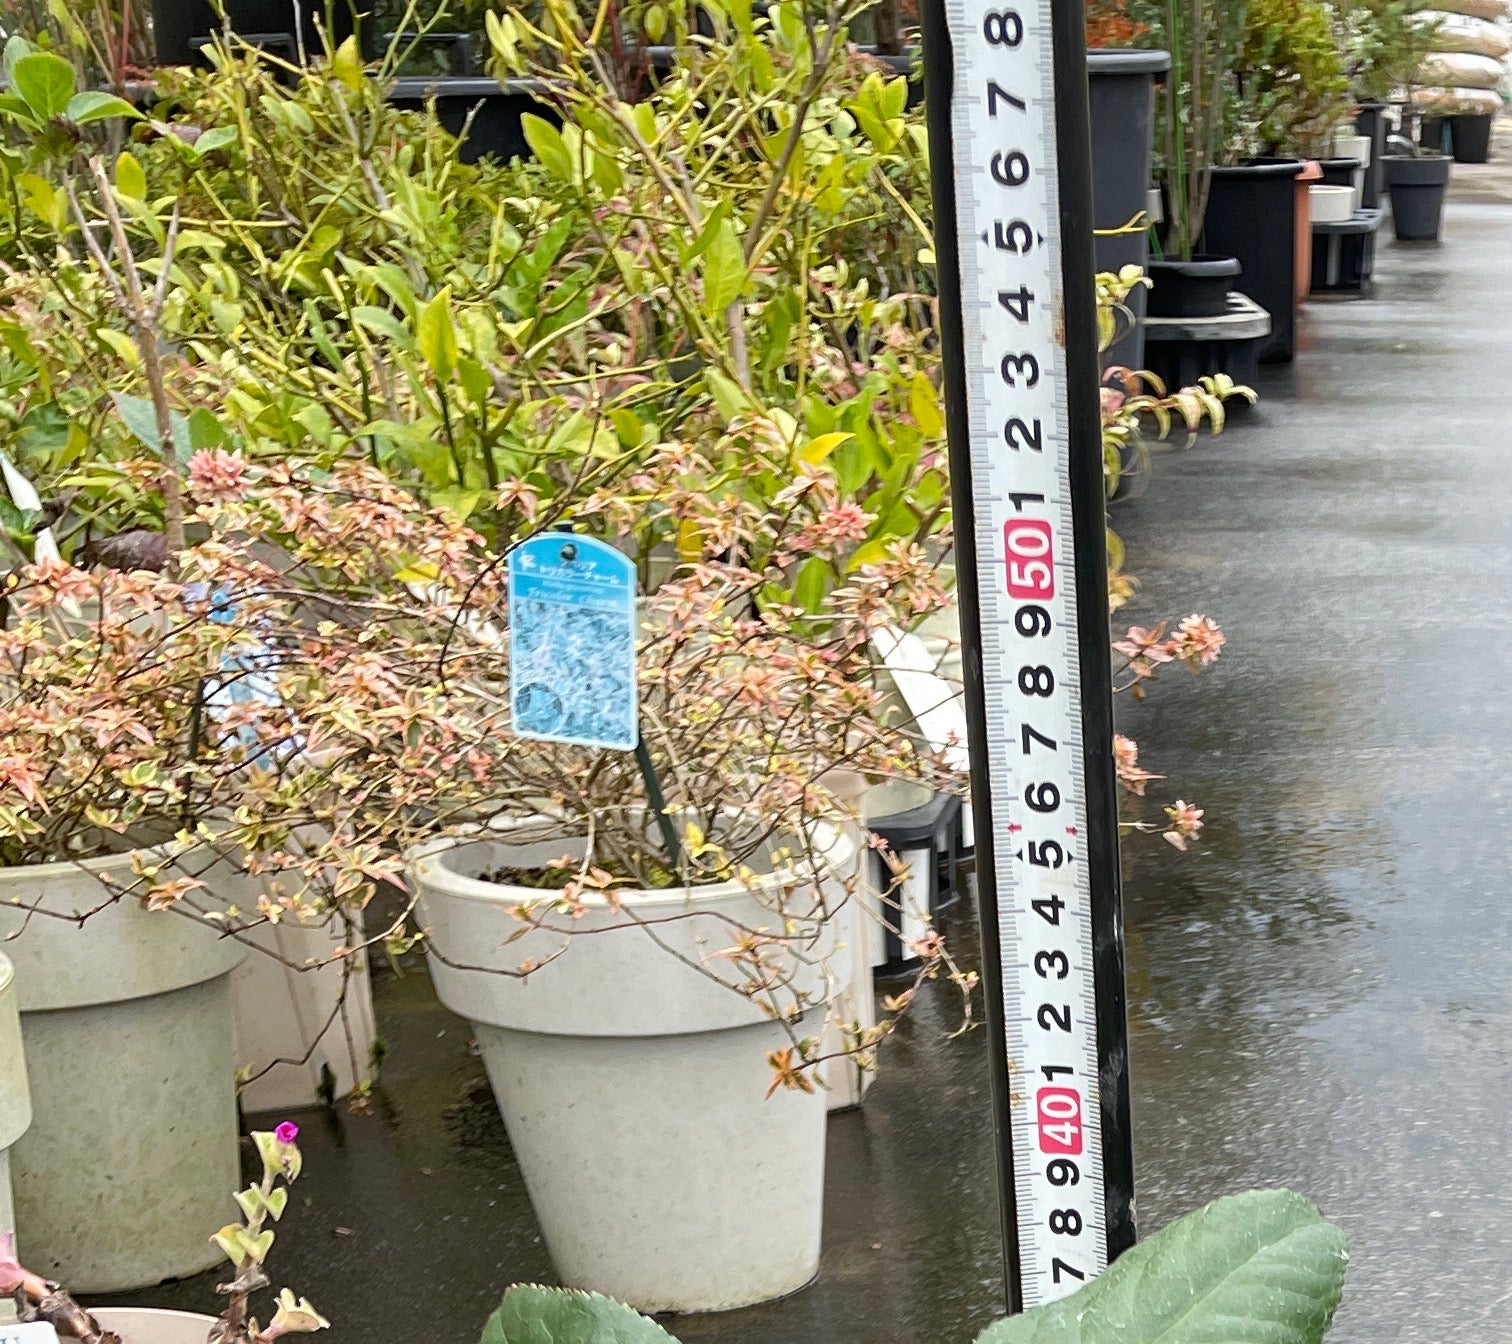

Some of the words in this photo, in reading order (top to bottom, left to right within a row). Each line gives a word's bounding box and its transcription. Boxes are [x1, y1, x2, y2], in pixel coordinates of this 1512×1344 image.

[983, 10, 1024, 47] 8
[987, 78, 1026, 119] 7
[990, 151, 1030, 187] 6
[994, 220, 1033, 256] 5
[998, 284, 1035, 324] 4
[1001, 352, 1039, 388] 3
[1004, 417, 1043, 453] 2
[1008, 492, 1045, 512] 1
[1007, 527, 1051, 590] 50
[1014, 604, 1051, 637] 9
[1017, 665, 1054, 698] 8
[1021, 723, 1058, 755] 7
[1025, 782, 1061, 814] 6
[1028, 839, 1063, 869] 5
[1031, 895, 1065, 926] 4
[1034, 949, 1069, 980] 3
[1037, 1003, 1072, 1033] 2
[1040, 1065, 1074, 1082] 1
[1040, 1094, 1079, 1146] 40
[1046, 1158, 1080, 1186] 9
[1049, 1208, 1083, 1236] 8
[1052, 1257, 1084, 1284] 7
